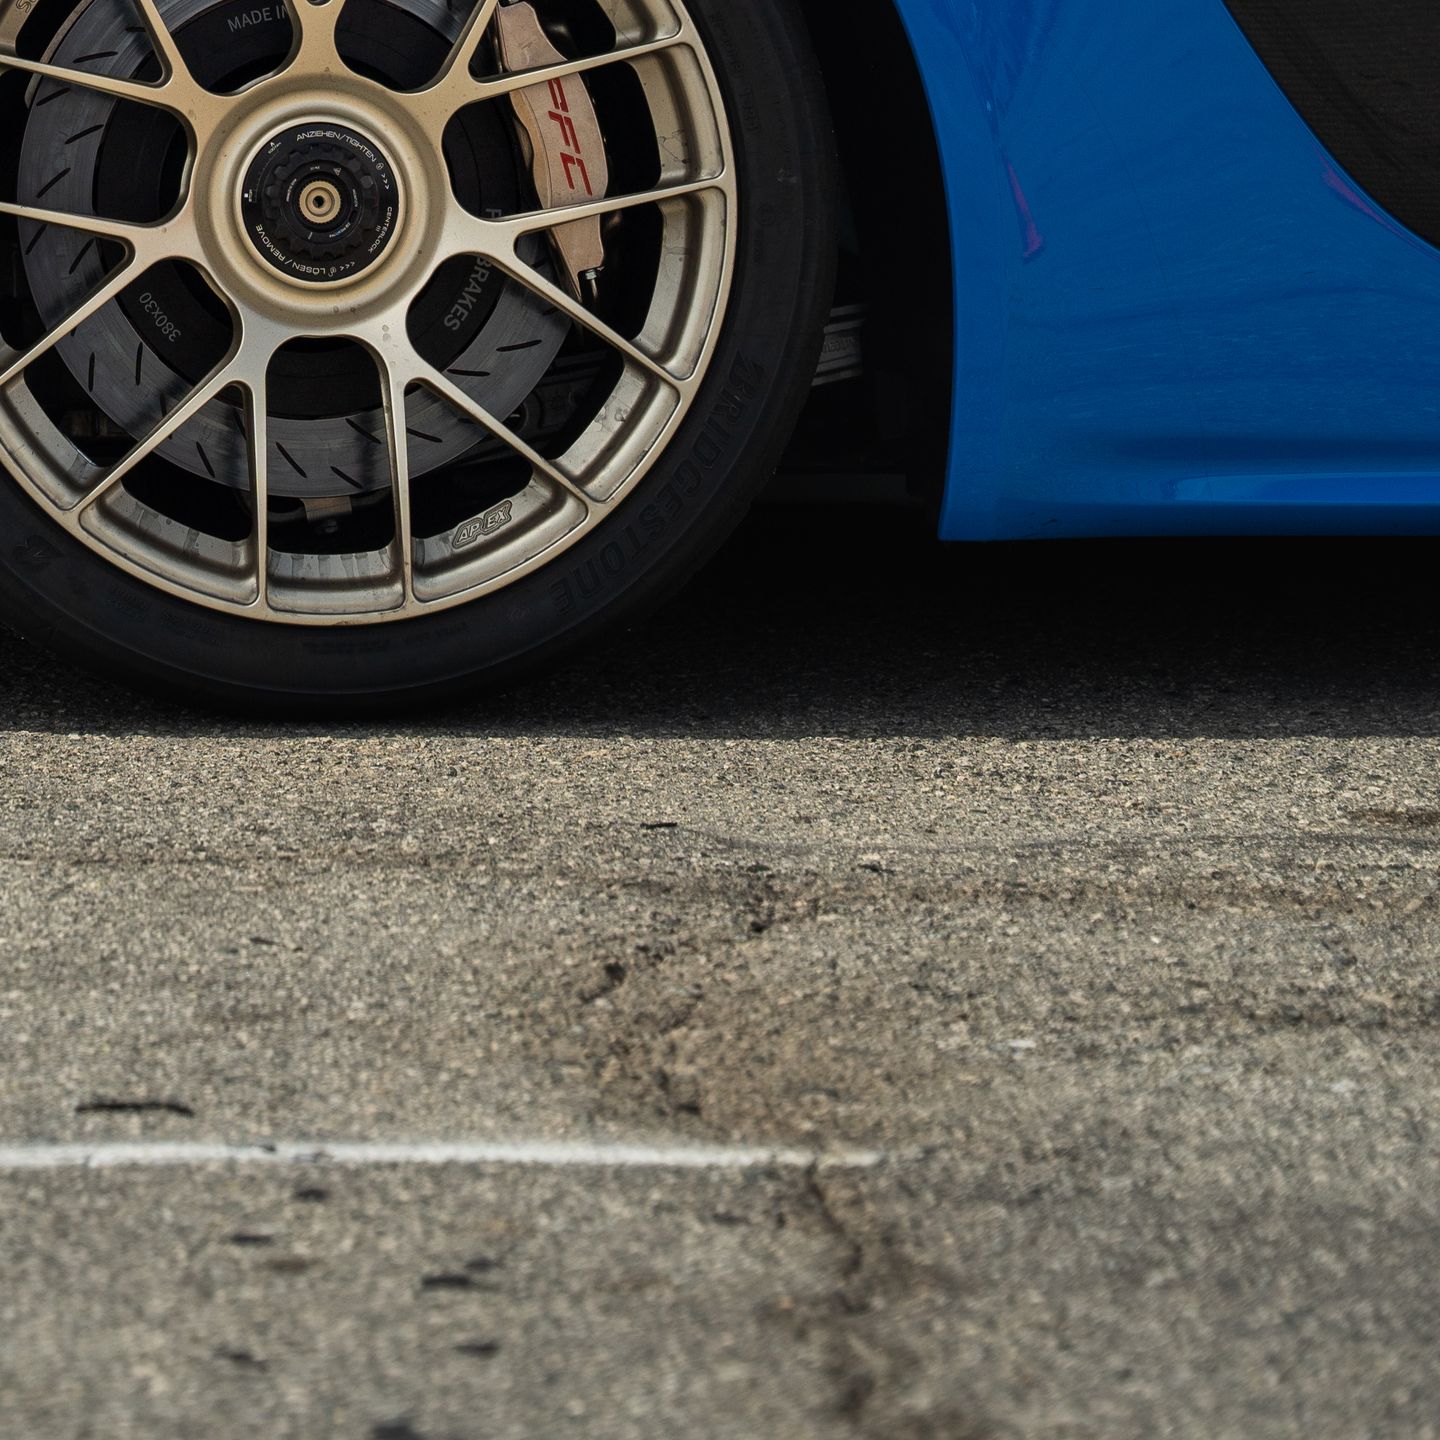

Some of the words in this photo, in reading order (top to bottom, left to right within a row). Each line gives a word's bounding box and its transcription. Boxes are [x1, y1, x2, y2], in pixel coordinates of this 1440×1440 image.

[227, 6, 273, 32] MADE
[255, 223, 286, 262] REMOVE
[367, 206, 393, 254] CENTERLOCK
[140, 292, 181, 342] 380x30
[549, 349, 765, 616] BRIDGESTONE
[454, 501, 511, 548] APEX
